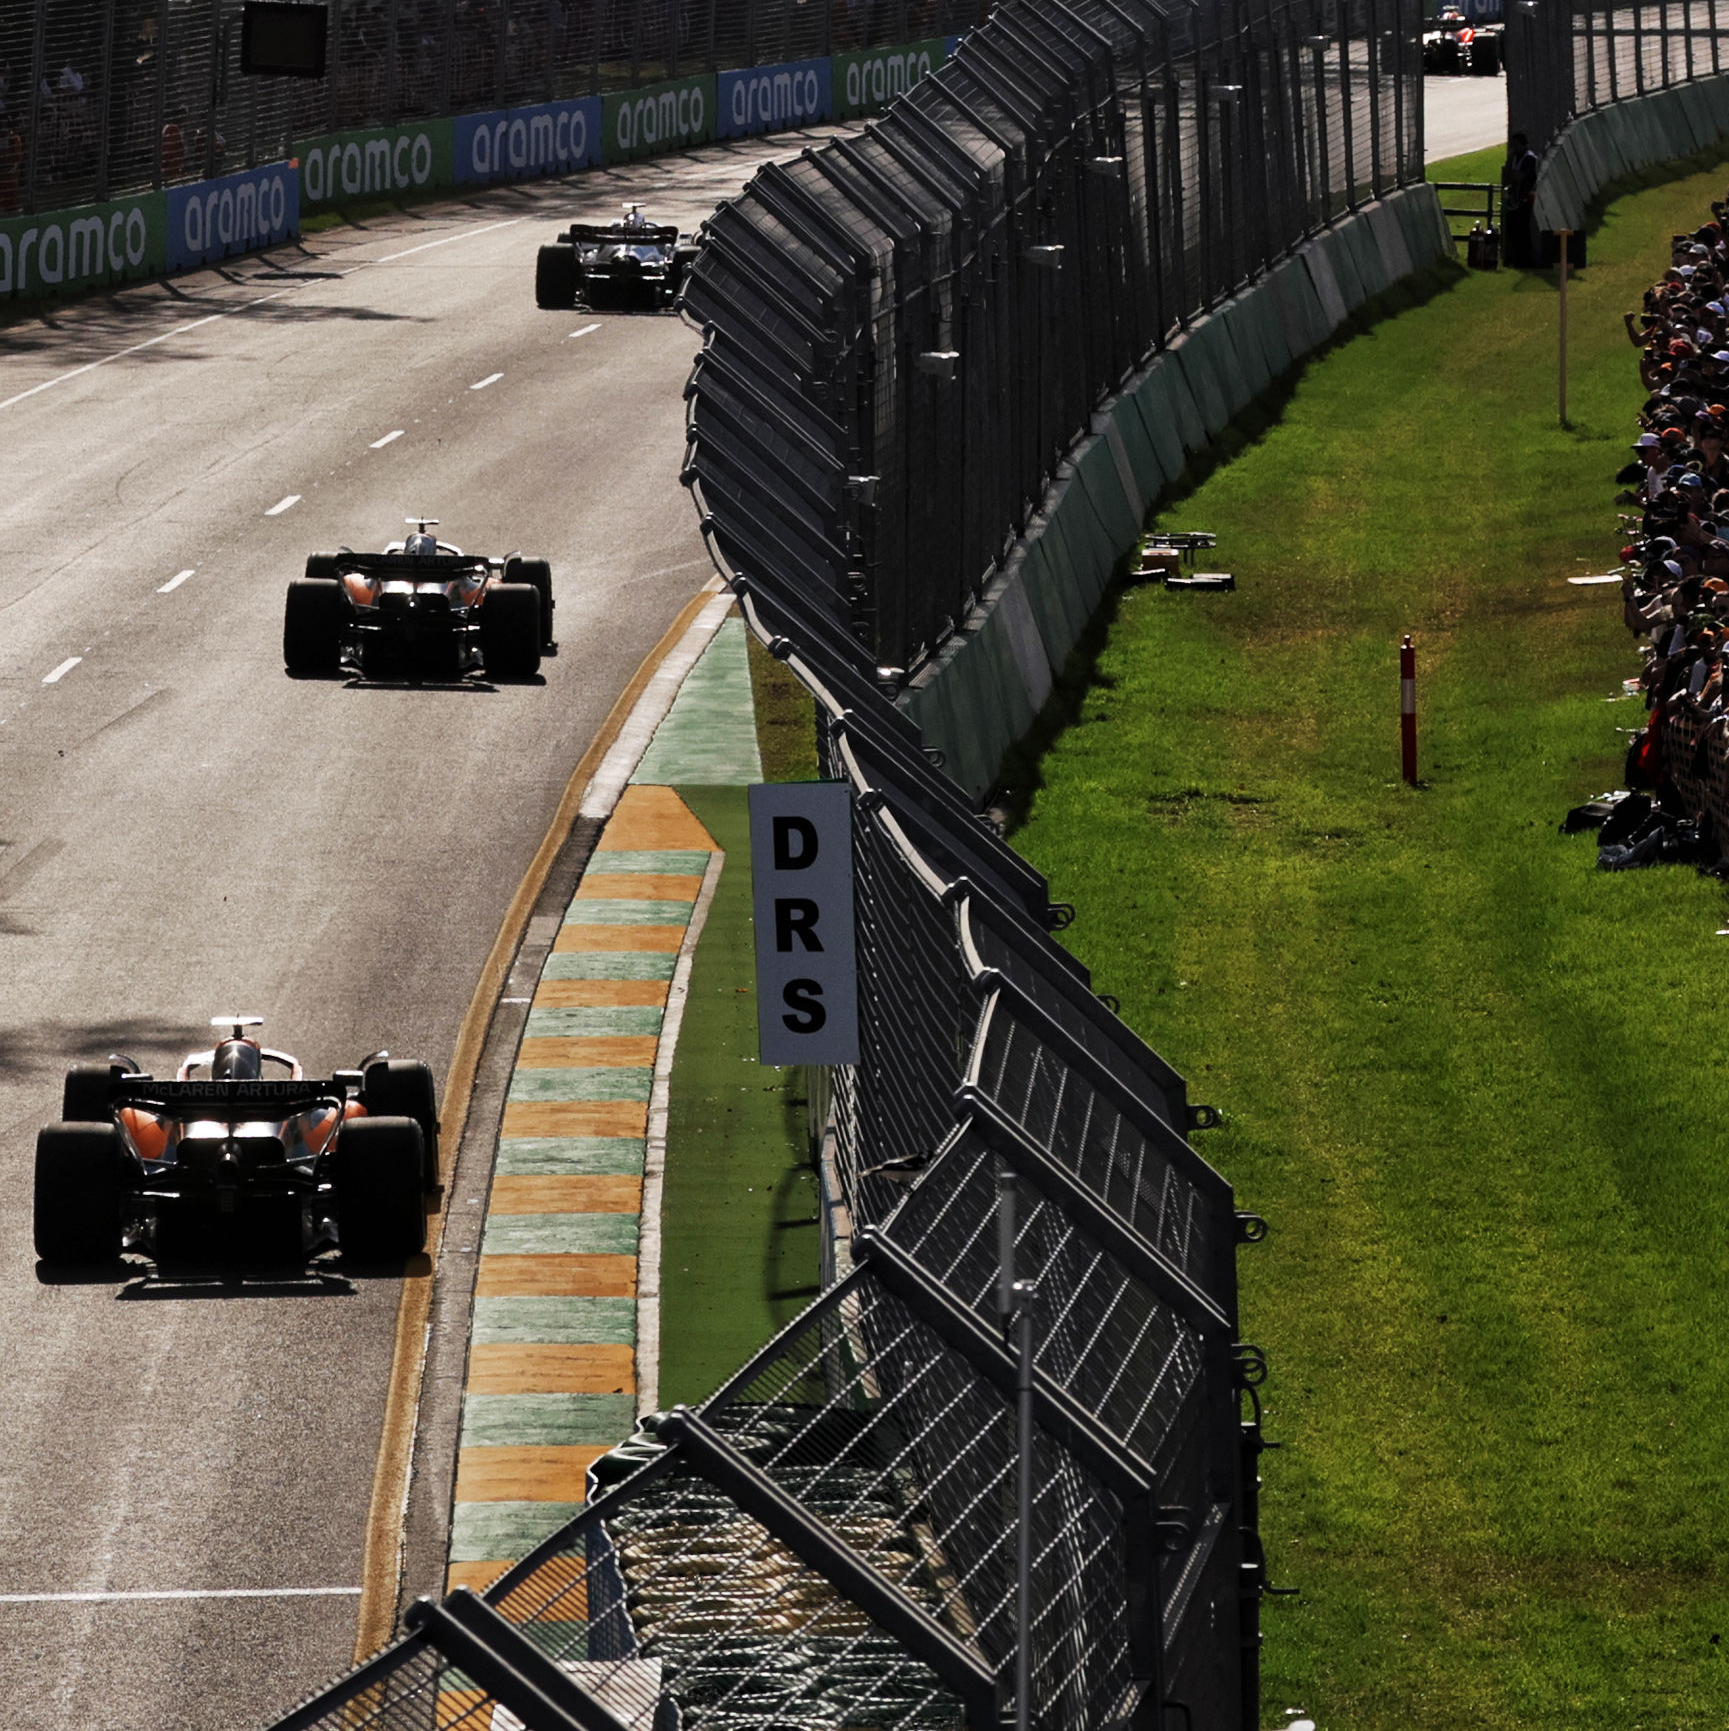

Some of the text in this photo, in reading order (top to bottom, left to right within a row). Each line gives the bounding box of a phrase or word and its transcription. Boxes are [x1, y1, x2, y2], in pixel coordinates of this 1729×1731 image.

[732, 69, 819, 126] aramco
[846, 51, 931, 105] aramco
[473, 109, 586, 173] aramco
[617, 87, 704, 150] aramco
[305, 133, 432, 201] aramco
[185, 175, 285, 252] aramco
[772, 815, 827, 1034] DRS
[142, 1082, 311, 1097] McLAREN ARTURA
